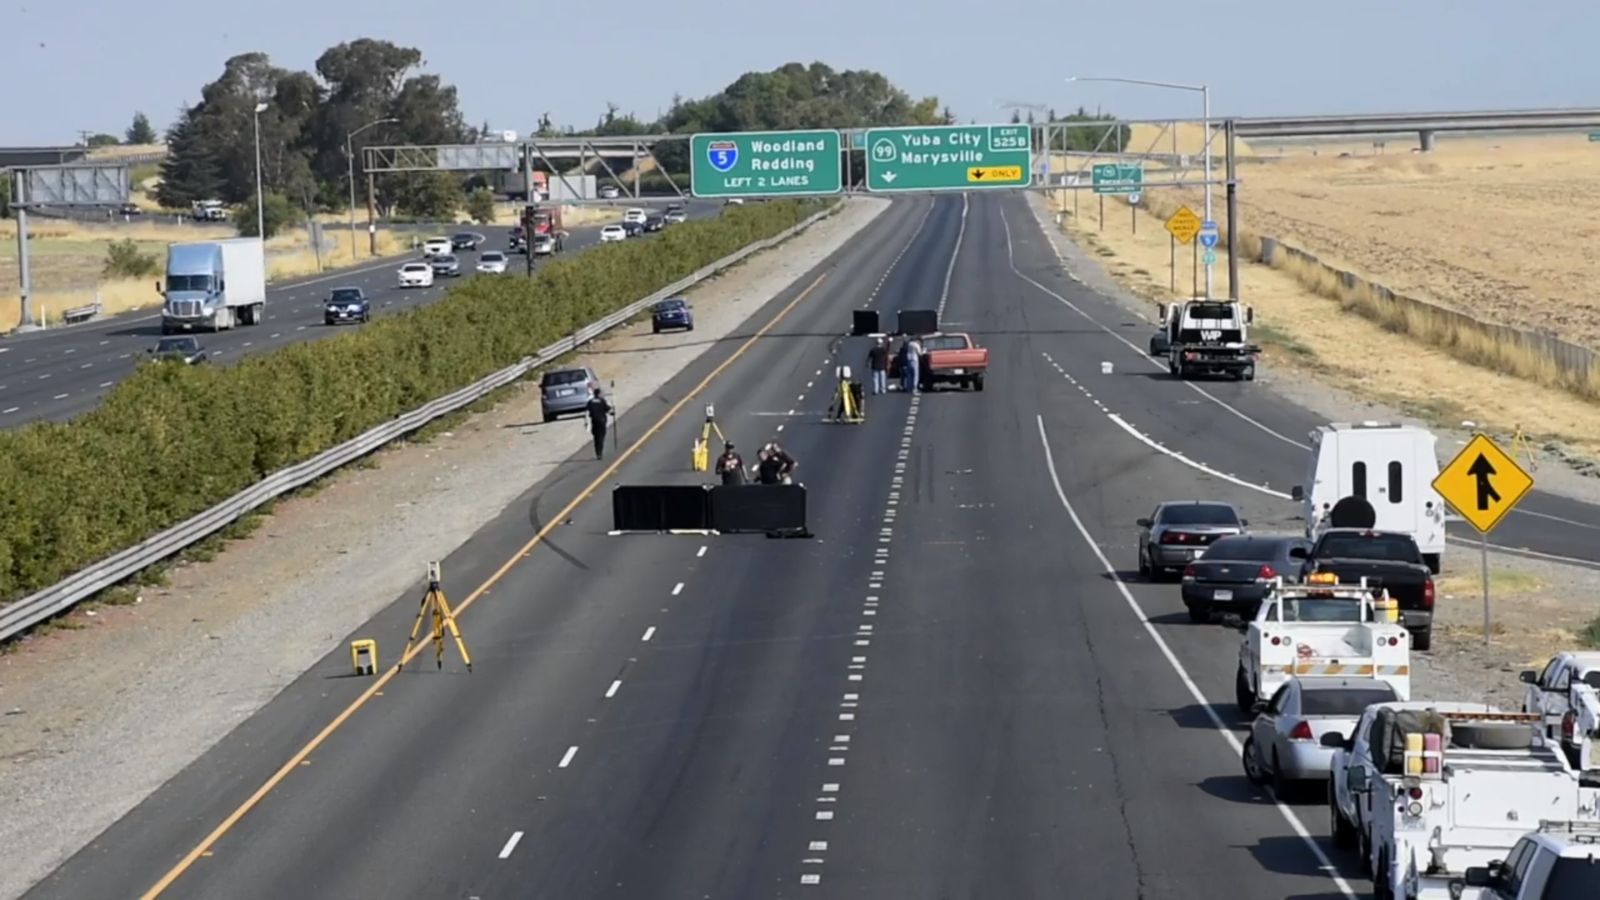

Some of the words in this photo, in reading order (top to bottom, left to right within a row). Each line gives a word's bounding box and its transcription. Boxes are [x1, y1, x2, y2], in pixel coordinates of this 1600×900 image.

[1000, 128, 1018, 136] EXIT
[751, 139, 825, 153] Woodland
[902, 134, 941, 147] Yuba
[949, 132, 981, 147] City
[717, 151, 728, 165] 5
[876, 145, 892, 157] 99
[751, 158, 815, 172] Redding
[901, 151, 983, 166] Marysville
[991, 169, 1017, 178] ONLY
[724, 177, 751, 188] LEFT
[758, 178, 765, 187] 2
[771, 175, 809, 187] LANES
